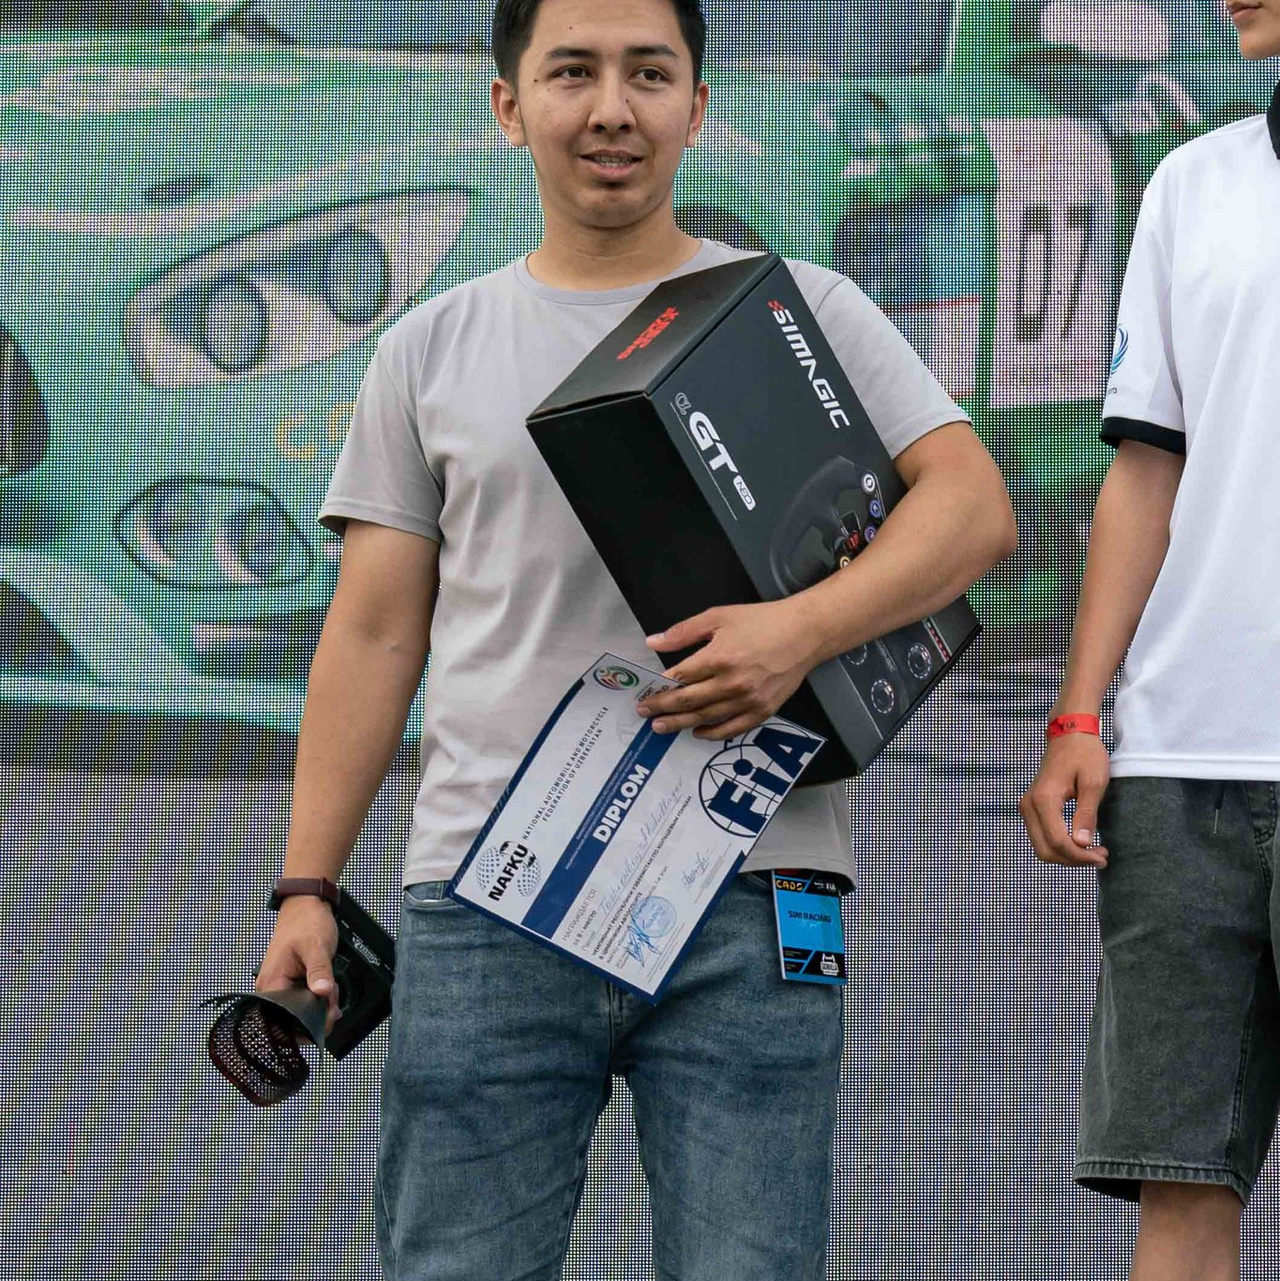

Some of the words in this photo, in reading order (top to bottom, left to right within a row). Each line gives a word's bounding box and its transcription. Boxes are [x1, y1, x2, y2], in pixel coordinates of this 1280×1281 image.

[1015, 202, 1093, 340] 07
[772, 307, 850, 430] SIMAGIC
[688, 410, 738, 481] GT
[521, 805, 546, 840] NATIONAL
[542, 761, 573, 806] AUTOMOBILE
[578, 705, 609, 748] MOTORCYCLE
[541, 778, 571, 822] FEDERATION
[573, 727, 603, 769] UZBEKISTAN
[592, 762, 651, 844] DIPLOM
[487, 842, 529, 903] NAFKU
